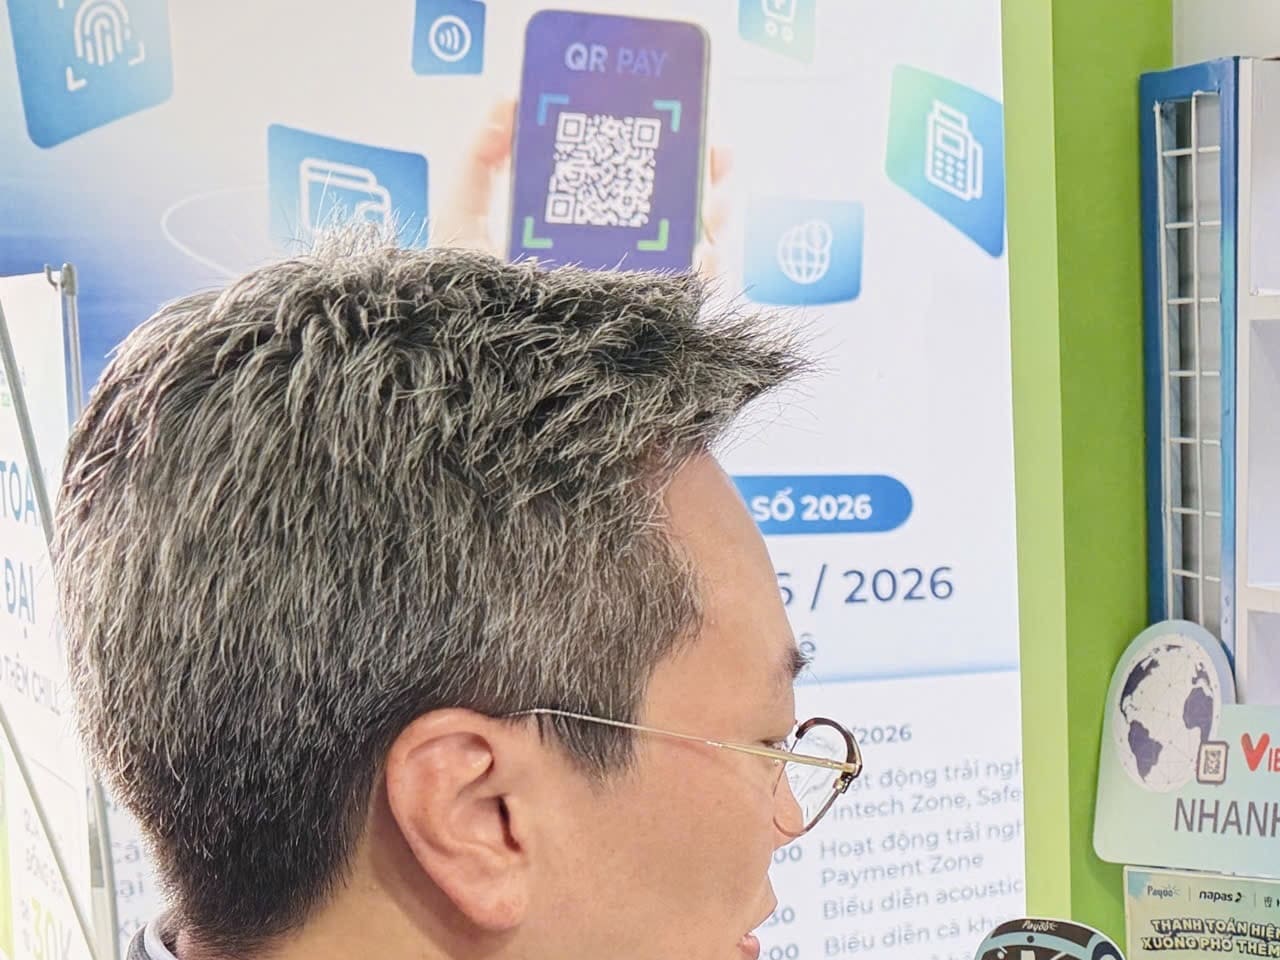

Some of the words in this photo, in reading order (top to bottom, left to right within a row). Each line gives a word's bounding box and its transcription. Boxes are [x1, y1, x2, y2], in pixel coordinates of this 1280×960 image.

[564, 42, 608, 72] QR
[616, 46, 669, 78] PAY
[753, 488, 795, 521] SỐ
[801, 494, 872, 521] 2026
[843, 566, 954, 604] 2026
[879, 767, 936, 789] động
[833, 797, 904, 819] intech
[819, 837, 873, 859] Hoạt
[881, 831, 939, 852] động
[946, 822, 980, 843] trải
[821, 861, 921, 888] Payment
[929, 854, 984, 874] Zone
[936, 876, 1022, 903] acoustic
[1200, 891, 1233, 902] napas
[1151, 919, 1203, 933] THANH
[1207, 917, 1248, 935] TOÁN
[1142, 931, 1199, 951] XUỐNG
[1201, 935, 1233, 951] PHỐ
[1237, 939, 1280, 957] THÊM
